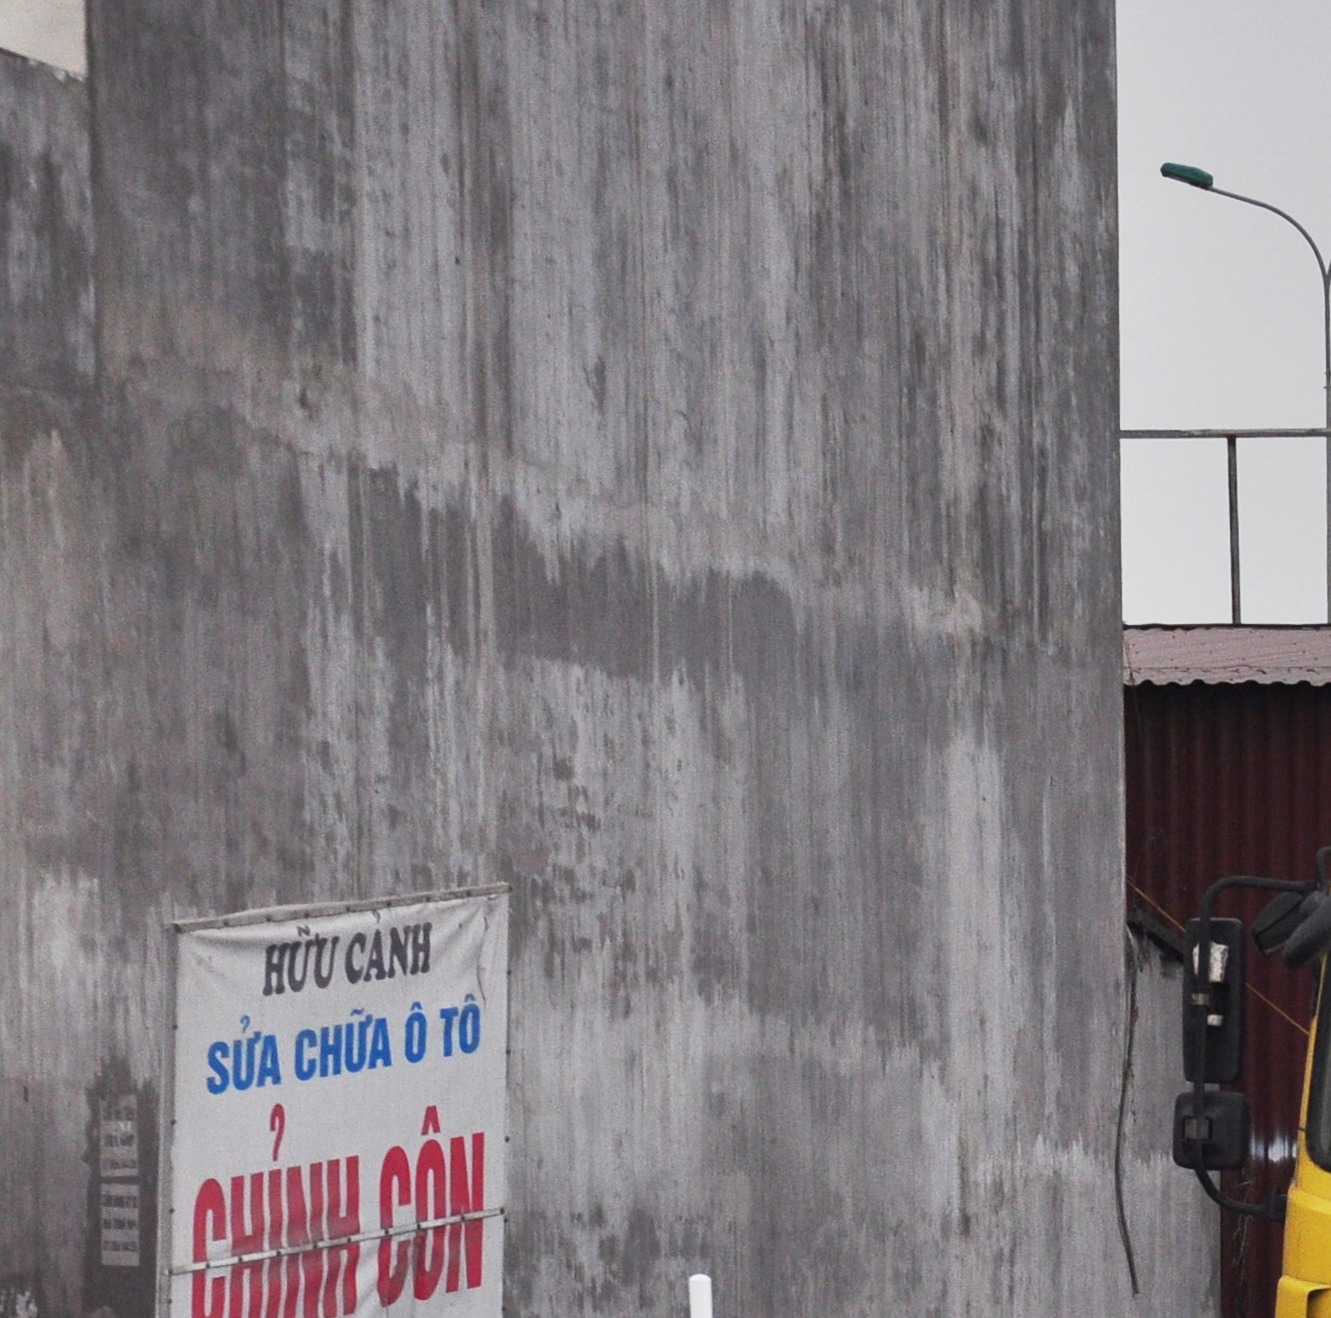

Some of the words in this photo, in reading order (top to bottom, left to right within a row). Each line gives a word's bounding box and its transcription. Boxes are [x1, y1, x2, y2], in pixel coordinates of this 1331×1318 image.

[262, 924, 341, 996] HỮU
[345, 908, 433, 985] CẢNH
[206, 1014, 282, 1095] SỬA
[294, 1007, 393, 1081] CHỮA
[404, 1001, 427, 1063] Ô
[440, 993, 481, 1057] TÔ
[377, 1105, 485, 1308] CÔN
